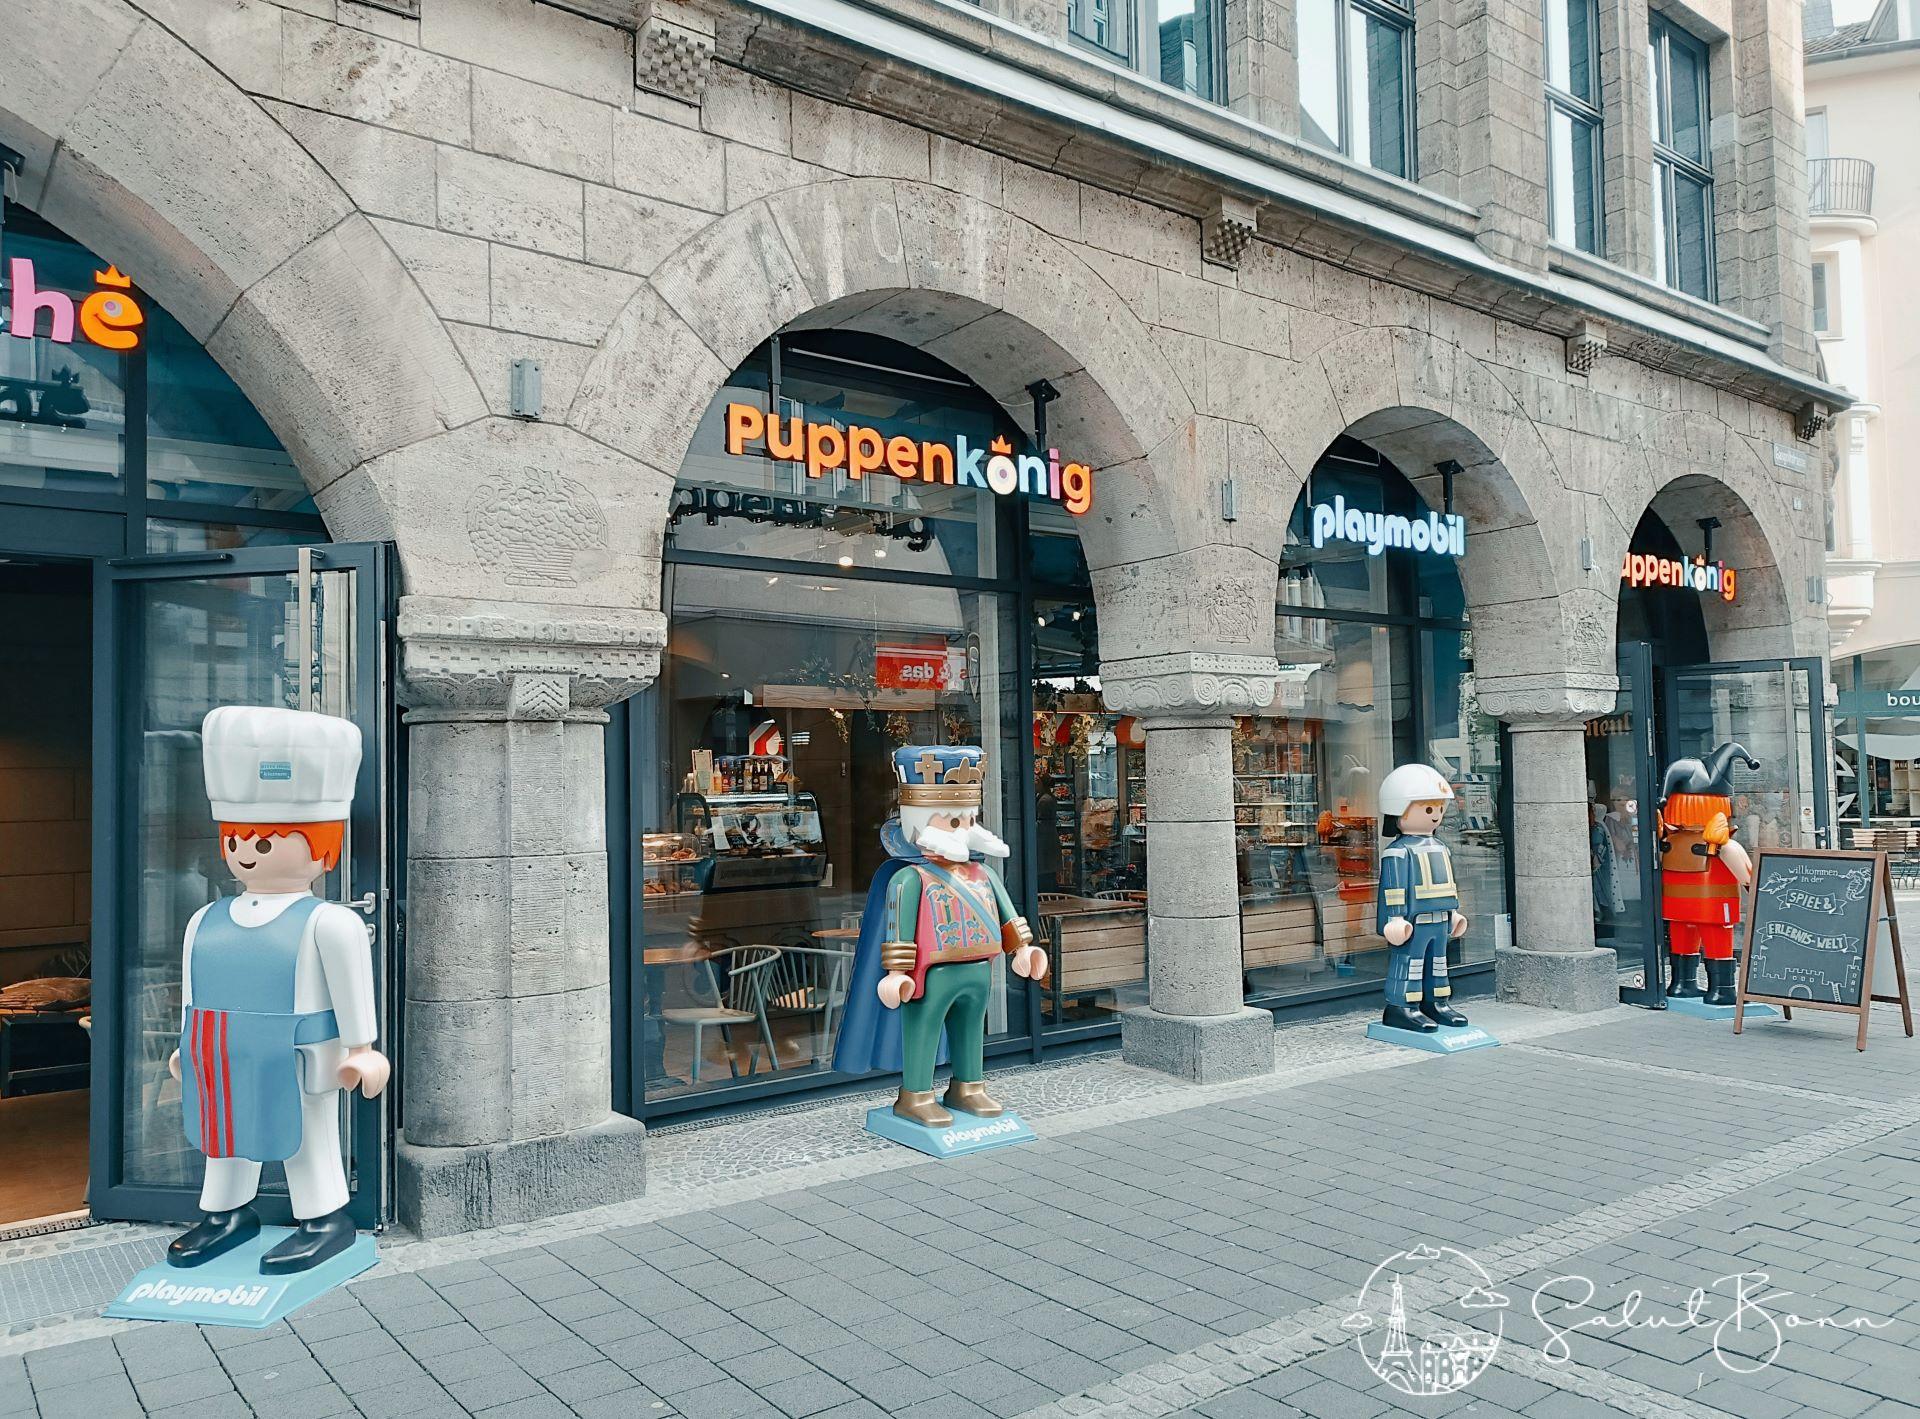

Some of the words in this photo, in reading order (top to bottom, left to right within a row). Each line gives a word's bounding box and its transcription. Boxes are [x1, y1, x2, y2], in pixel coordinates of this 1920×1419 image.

[0, 257, 144, 350] he
[1313, 494, 1466, 556] playmobil
[1620, 552, 1737, 601] uppenkönig
[1788, 865, 1839, 877] willkommen
[1810, 875, 1824, 883] der
[1823, 897, 1833, 910] &
[1768, 923, 1844, 949] ERLEBNIS-WELT
[941, 1118, 1021, 1148] playmobil
[126, 1279, 270, 1307] playmobil
